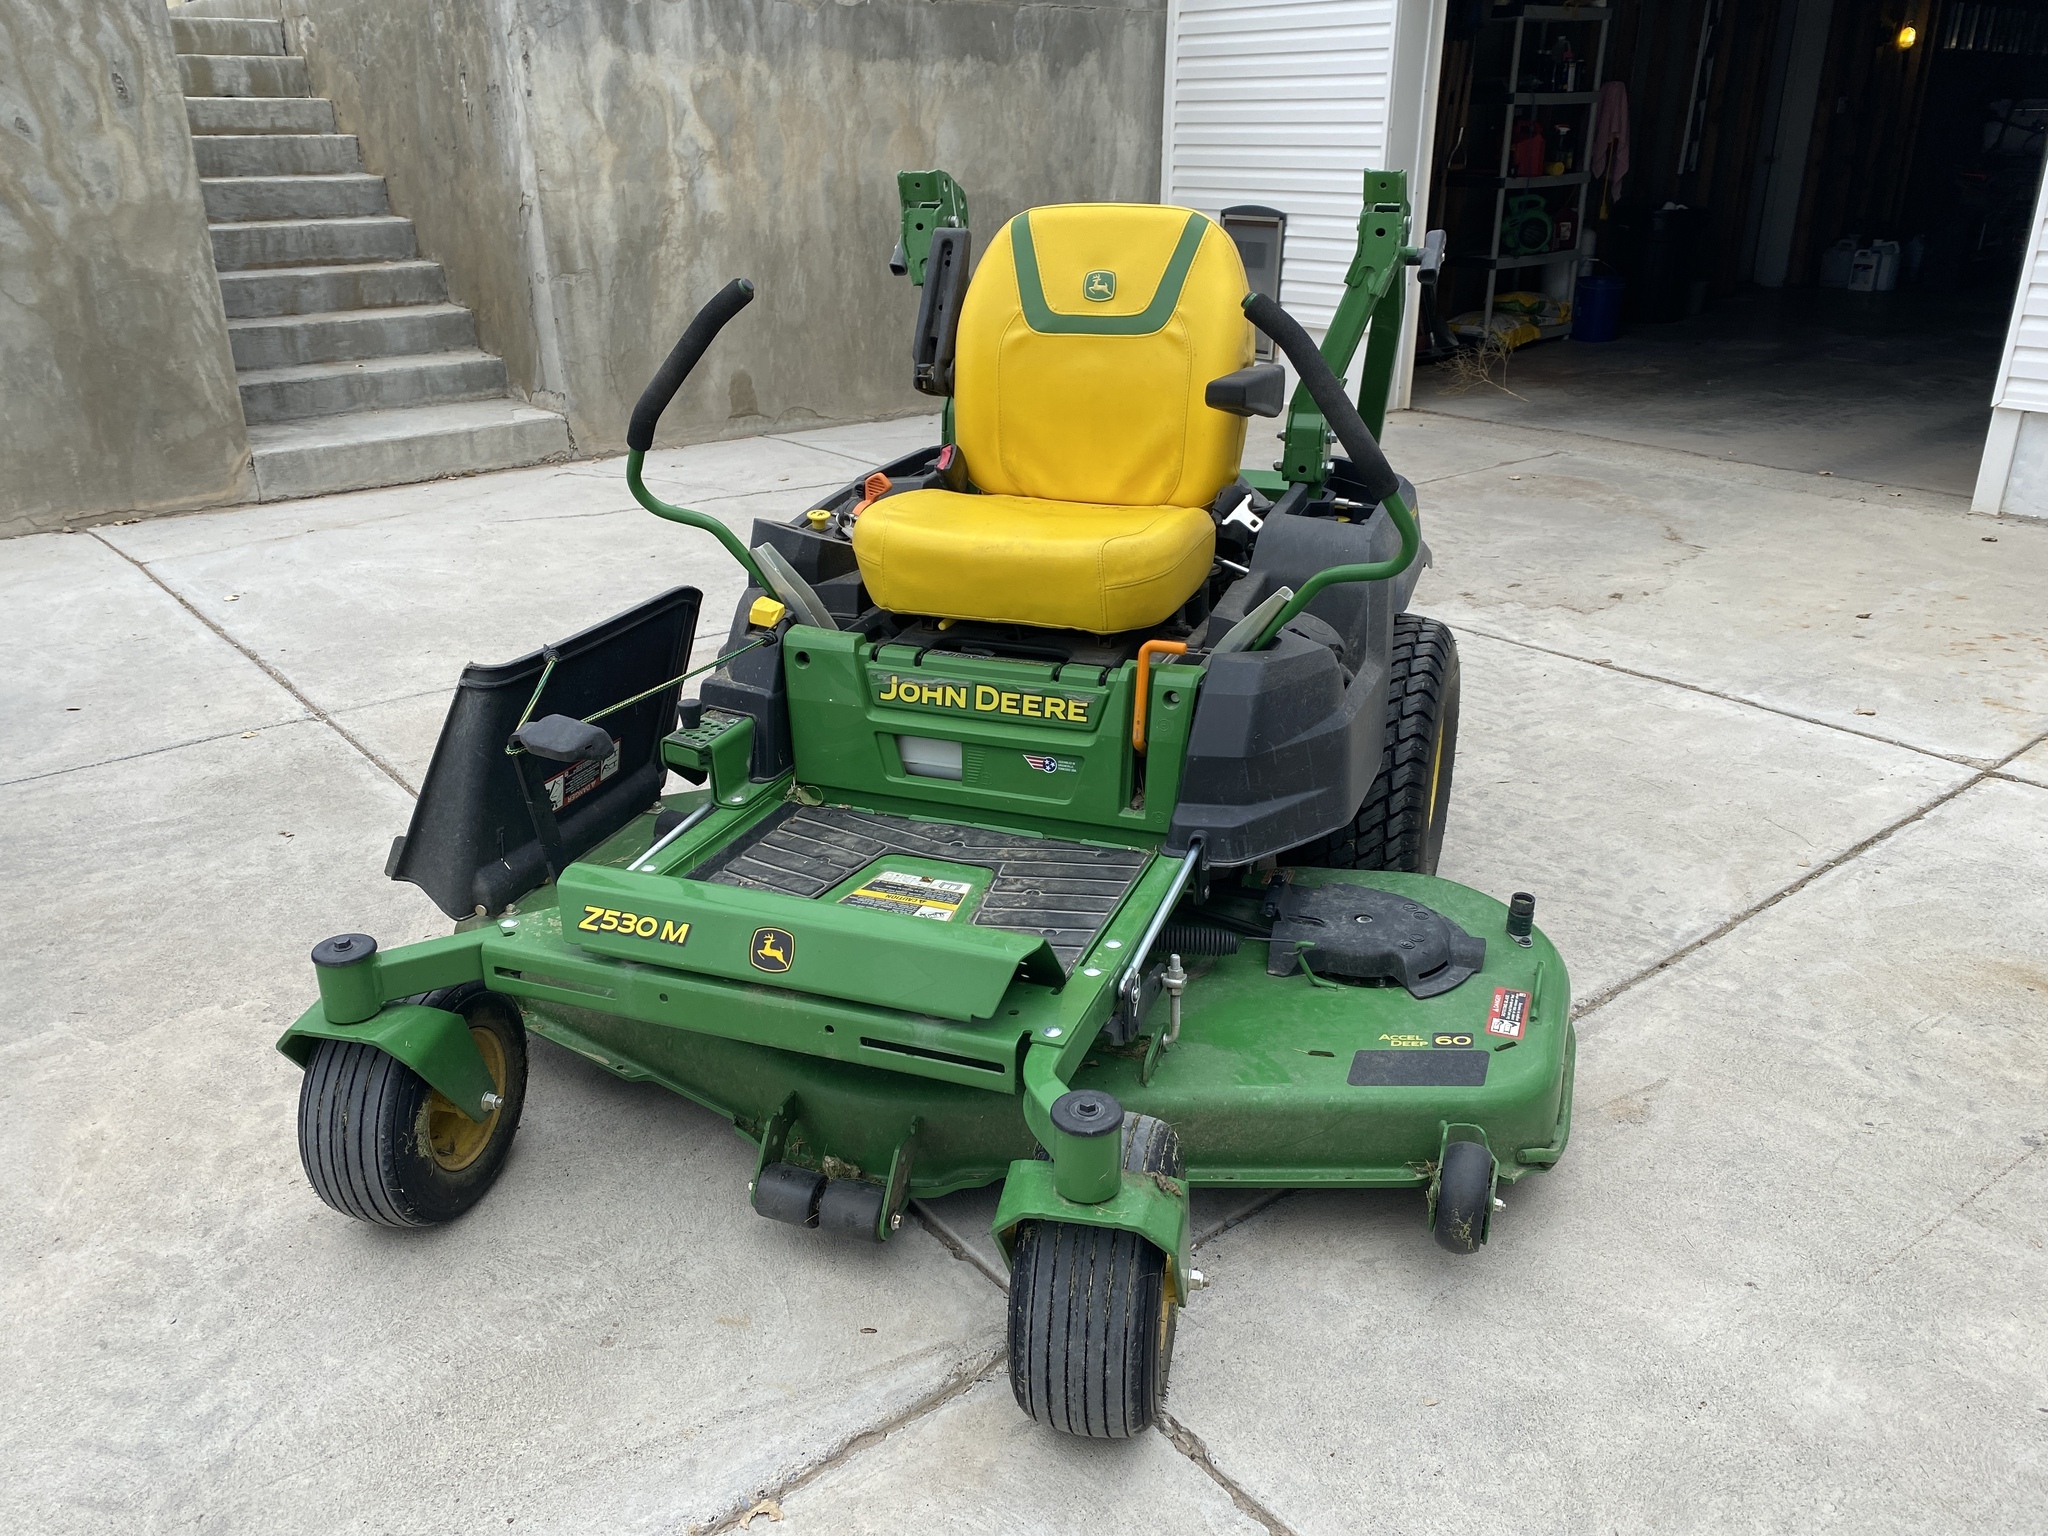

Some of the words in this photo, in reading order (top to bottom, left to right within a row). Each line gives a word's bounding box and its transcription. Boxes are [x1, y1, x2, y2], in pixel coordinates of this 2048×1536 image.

[879, 675, 968, 710] JOHN
[974, 684, 1089, 724] DEERE
[885, 894, 919, 904] CAUTION
[577, 905, 658, 938] Z530
[659, 920, 691, 945] M
[1492, 993, 1502, 1010] DANGER
[1378, 1033, 1424, 1041] ACCEL
[1434, 1036, 1472, 1046] 60
